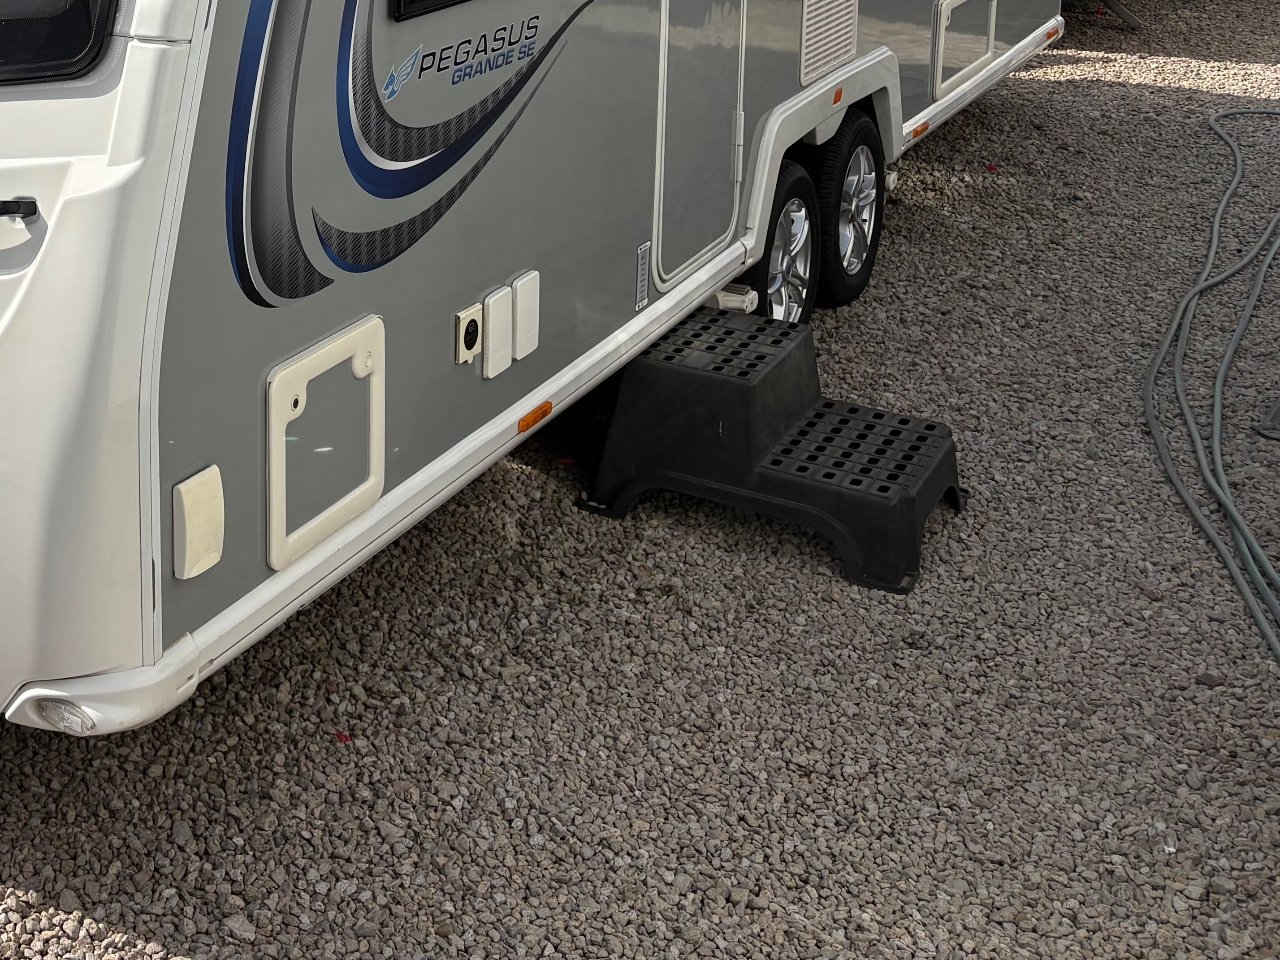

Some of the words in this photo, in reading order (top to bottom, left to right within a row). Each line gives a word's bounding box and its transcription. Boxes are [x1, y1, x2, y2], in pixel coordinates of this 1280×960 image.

[418, 15, 540, 80] PEGASUS
[451, 48, 515, 86] GRANDE
[517, 41, 536, 61] SE
